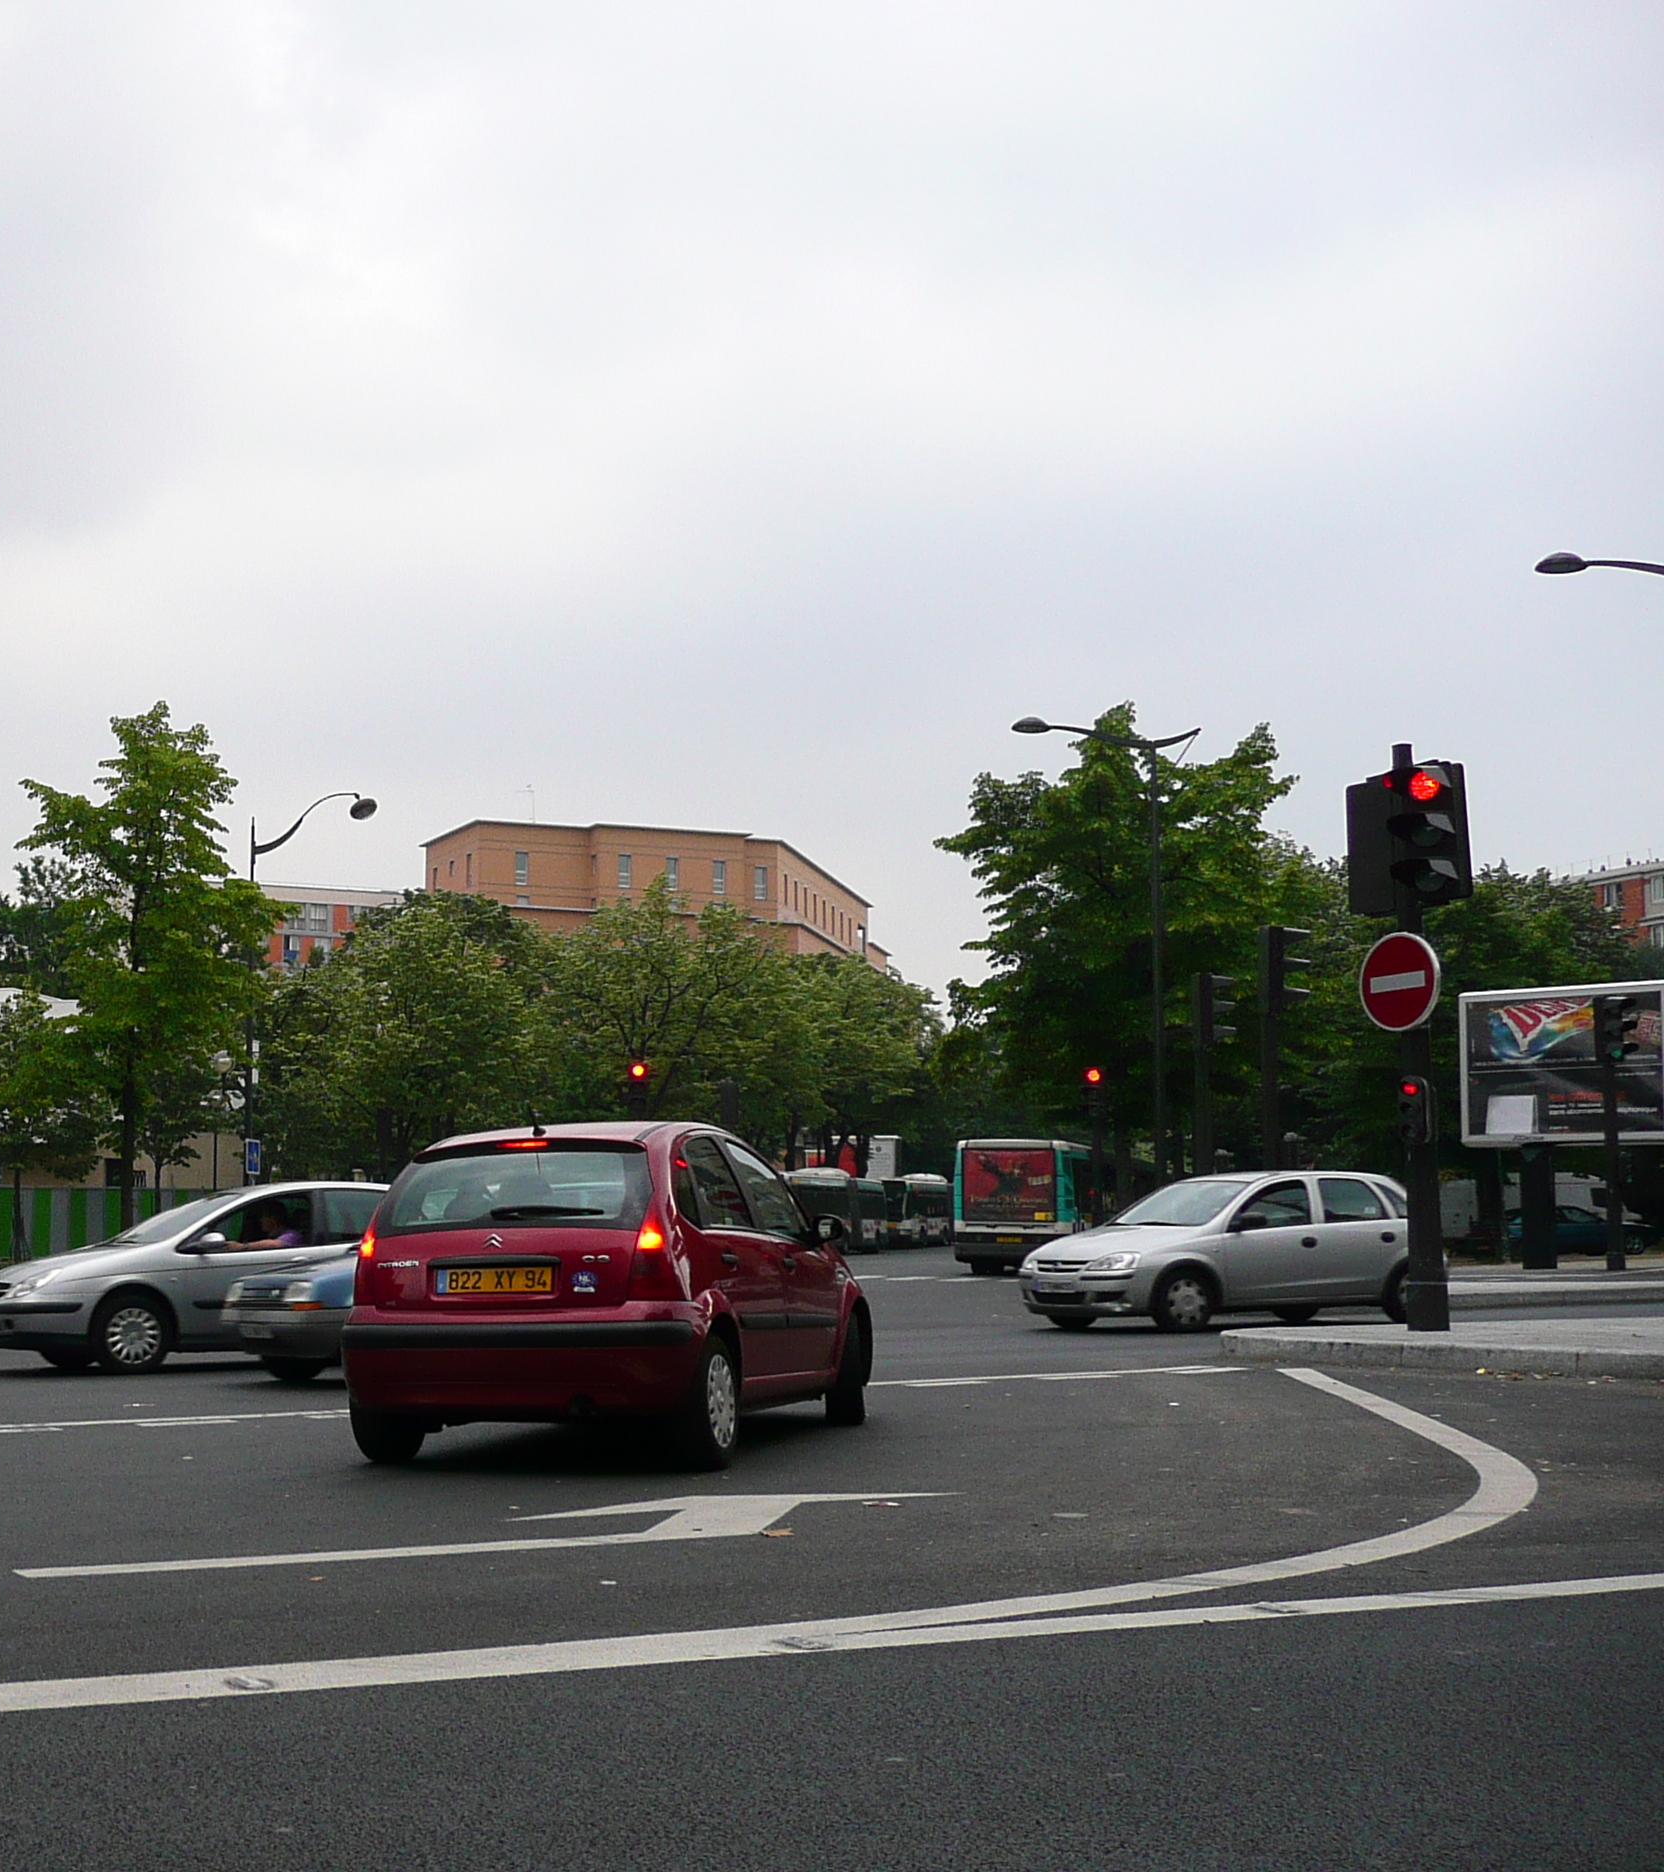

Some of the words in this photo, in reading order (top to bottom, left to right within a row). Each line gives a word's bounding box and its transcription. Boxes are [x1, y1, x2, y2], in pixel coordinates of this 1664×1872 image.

[448, 1271, 482, 1290] 822
[494, 1270, 517, 1289] XY
[525, 1269, 547, 1289] 94
